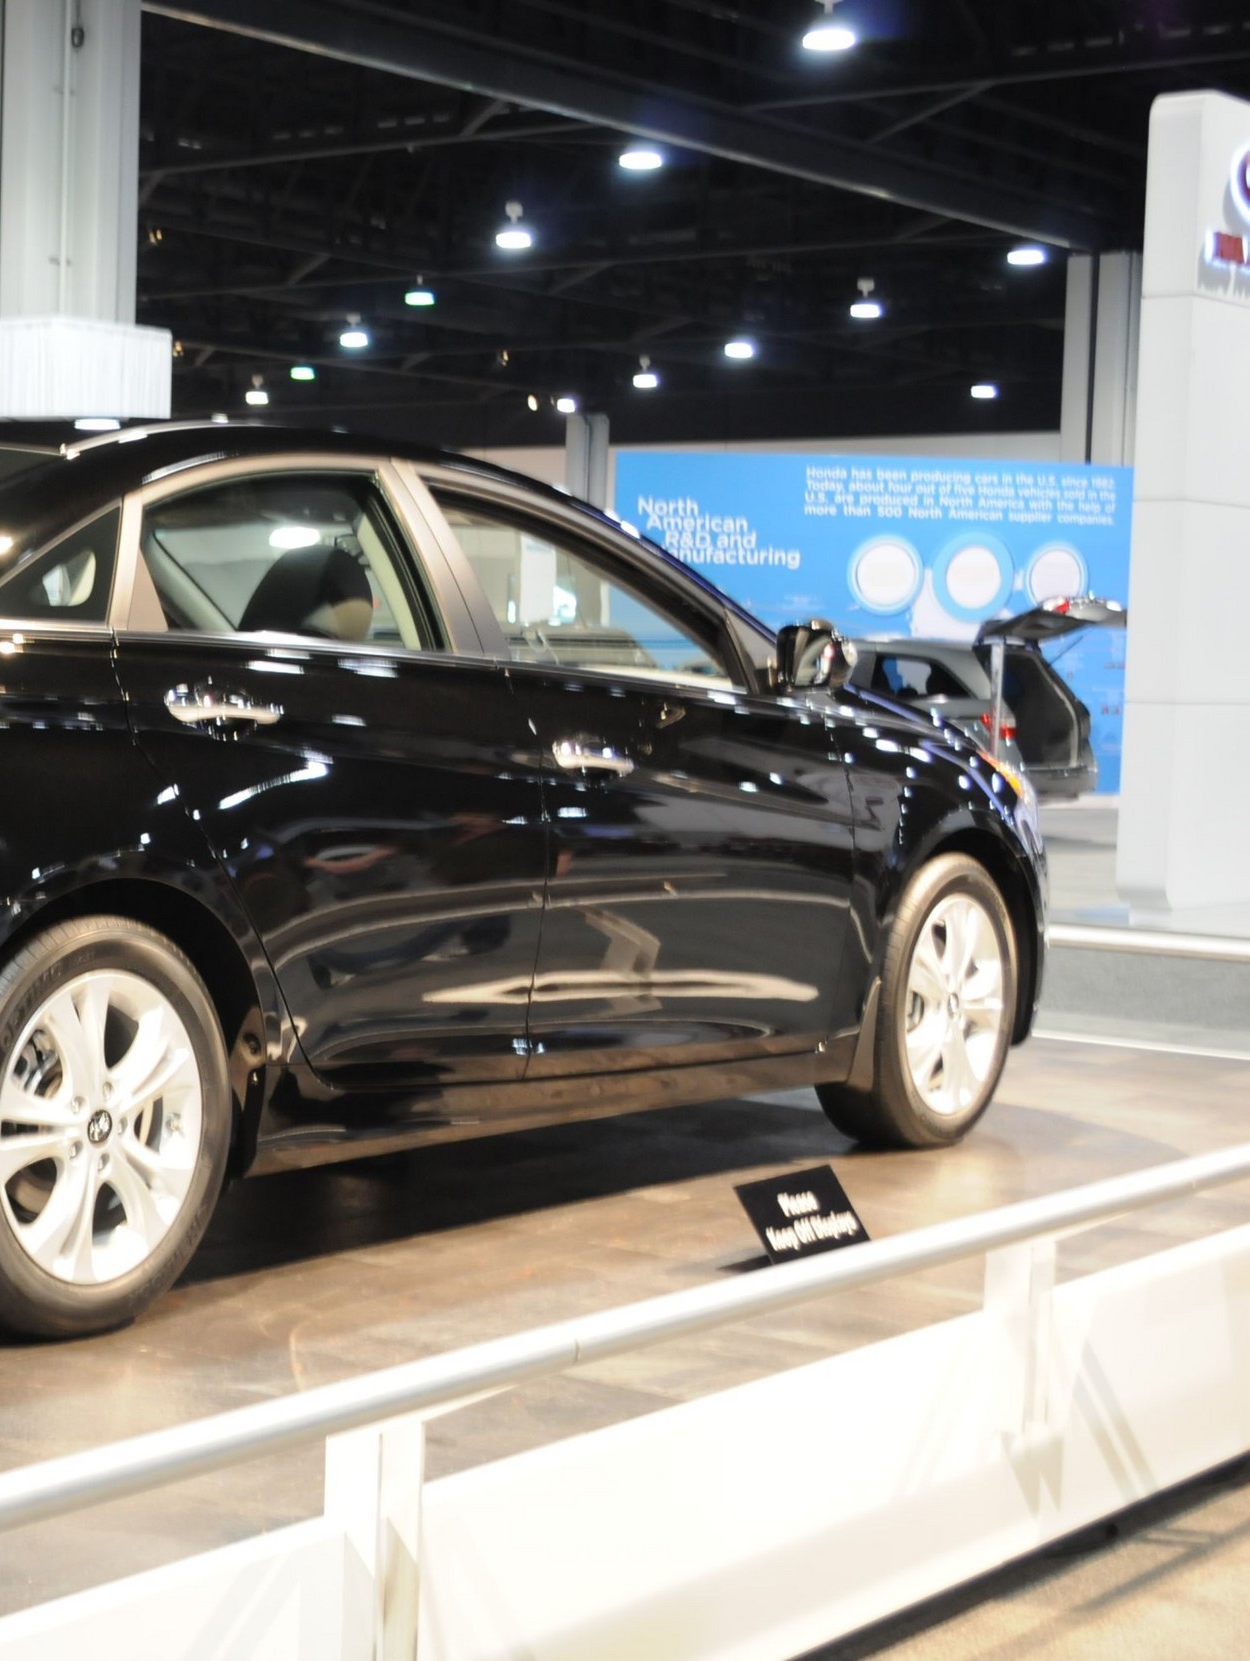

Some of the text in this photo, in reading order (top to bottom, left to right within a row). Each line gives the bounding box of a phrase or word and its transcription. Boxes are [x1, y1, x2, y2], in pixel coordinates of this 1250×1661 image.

[806, 467, 847, 481] Honda
[851, 468, 872, 481] has
[876, 468, 907, 481] been
[911, 470, 971, 486] producing
[975, 474, 998, 485] cars
[1002, 472, 1012, 484] in
[1016, 472, 1034, 485] the
[849, 481, 884, 492] about
[888, 482, 912, 493] four
[978, 485, 1015, 497] Honda
[1018, 486, 1060, 499] vehicles
[638, 496, 699, 517] North
[859, 494, 918, 506] produced
[938, 496, 973, 508] North
[978, 498, 1024, 510] America
[1029, 499, 1052, 511] with
[1057, 500, 1074, 511] the
[1078, 501, 1101, 513] help
[646, 513, 748, 533] American
[804, 505, 837, 516] more
[843, 505, 870, 517] than
[908, 507, 942, 519] North
[949, 508, 1003, 521] American
[1008, 511, 1052, 524] supplier
[665, 529, 757, 549] R&D and
[665, 546, 800, 569] anufacturing
